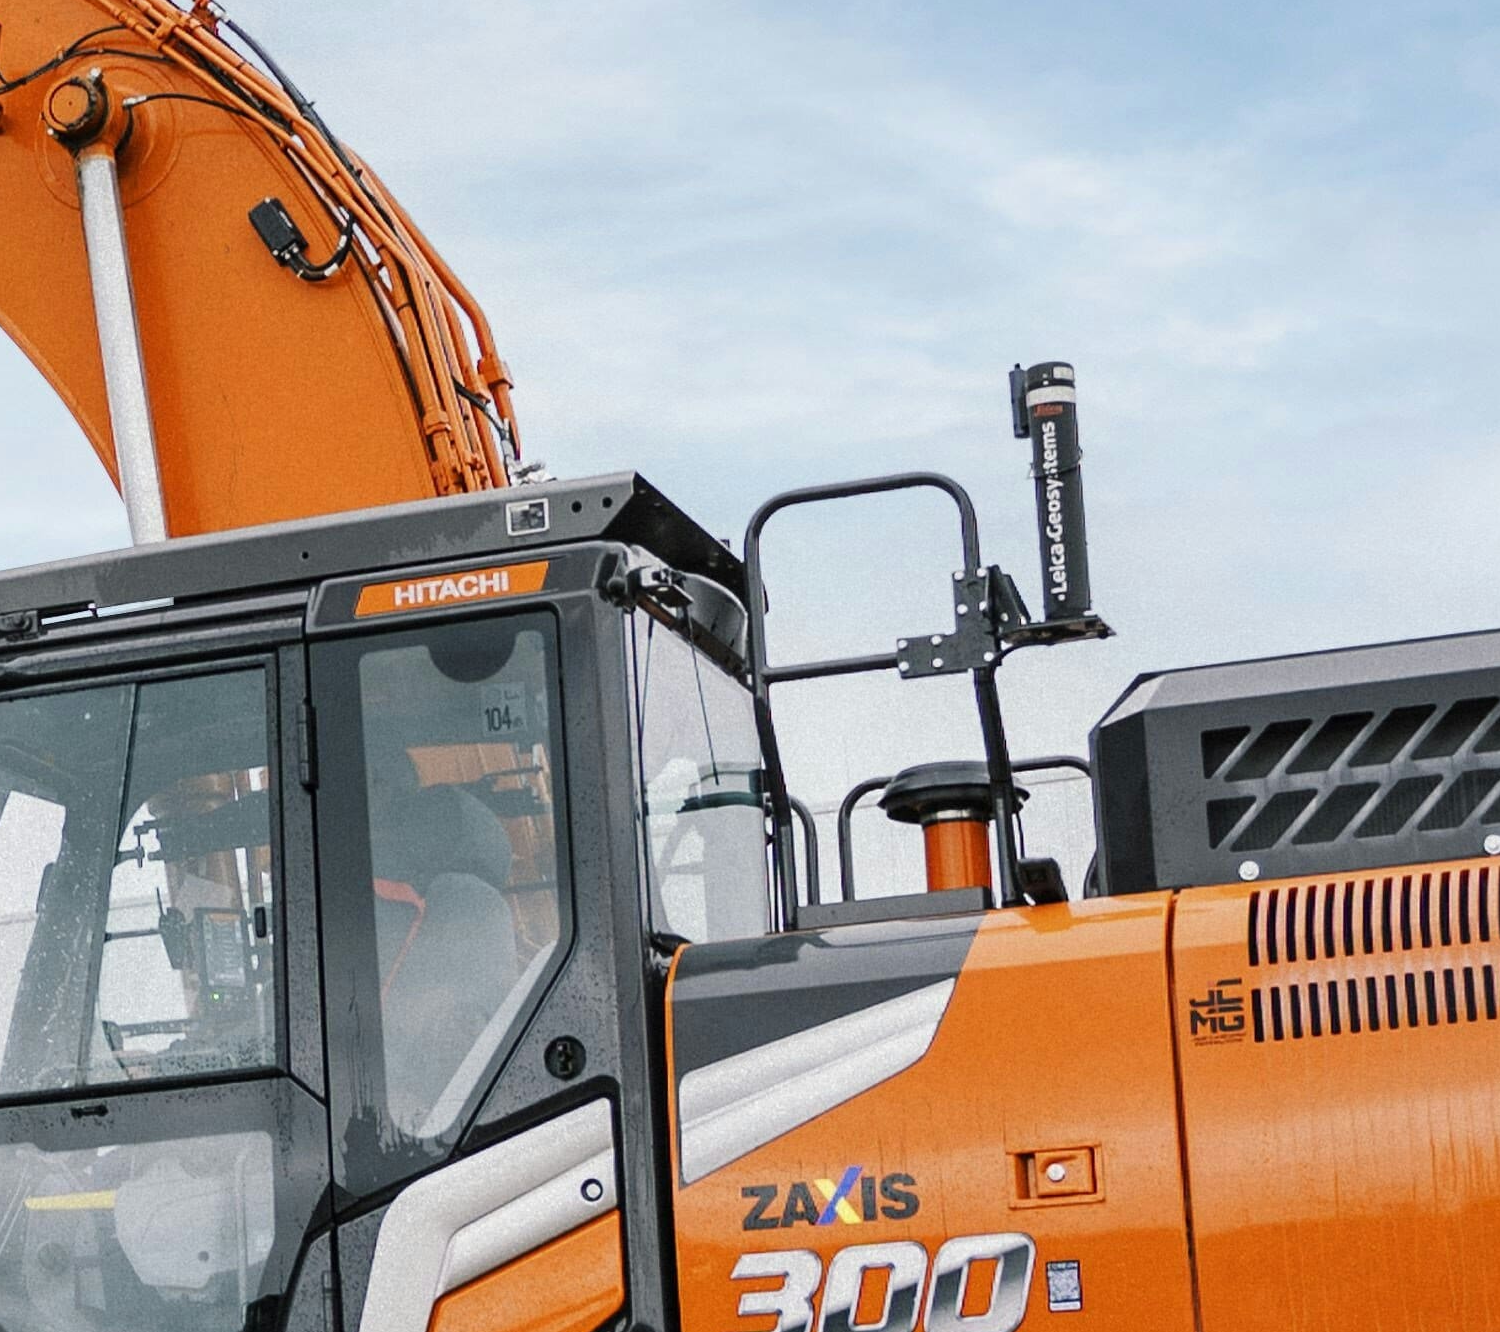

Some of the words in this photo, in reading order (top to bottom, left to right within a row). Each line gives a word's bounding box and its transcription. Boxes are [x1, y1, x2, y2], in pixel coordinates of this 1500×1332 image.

[394, 571, 510, 606] HITACHI
[484, 704, 513, 733] 104
[741, 1165, 920, 1231] ZAXIS
